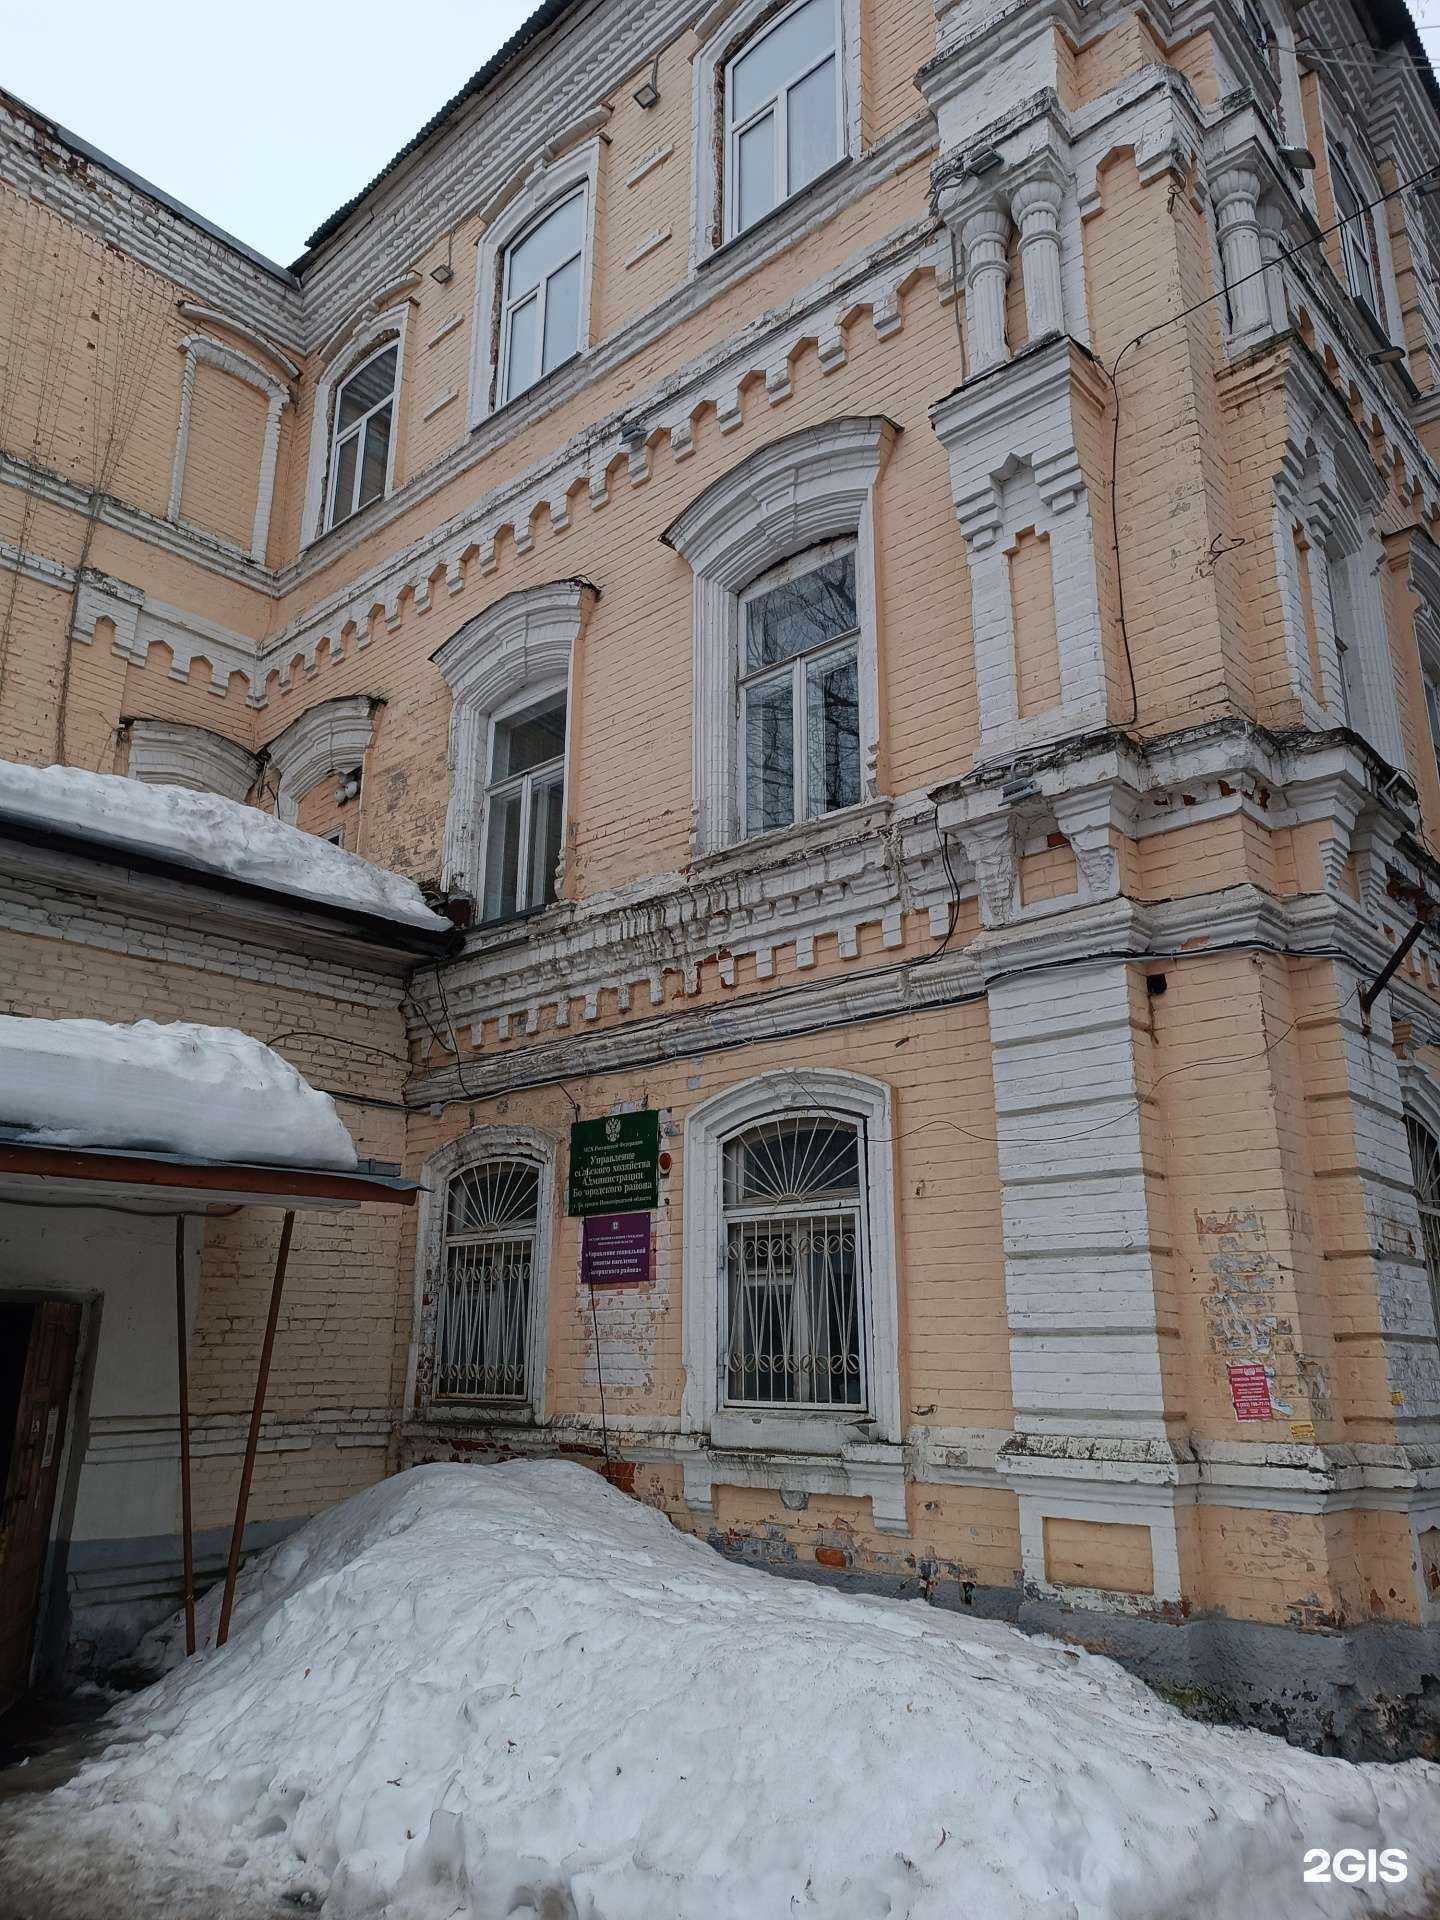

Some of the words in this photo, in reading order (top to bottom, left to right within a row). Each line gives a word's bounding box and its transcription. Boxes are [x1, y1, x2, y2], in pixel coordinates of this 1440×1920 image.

[590, 1152, 635, 1165] Управление
[613, 1160, 651, 1171] хозяйства
[583, 1172, 643, 1186] Администрации
[624, 1181, 652, 1193] района
